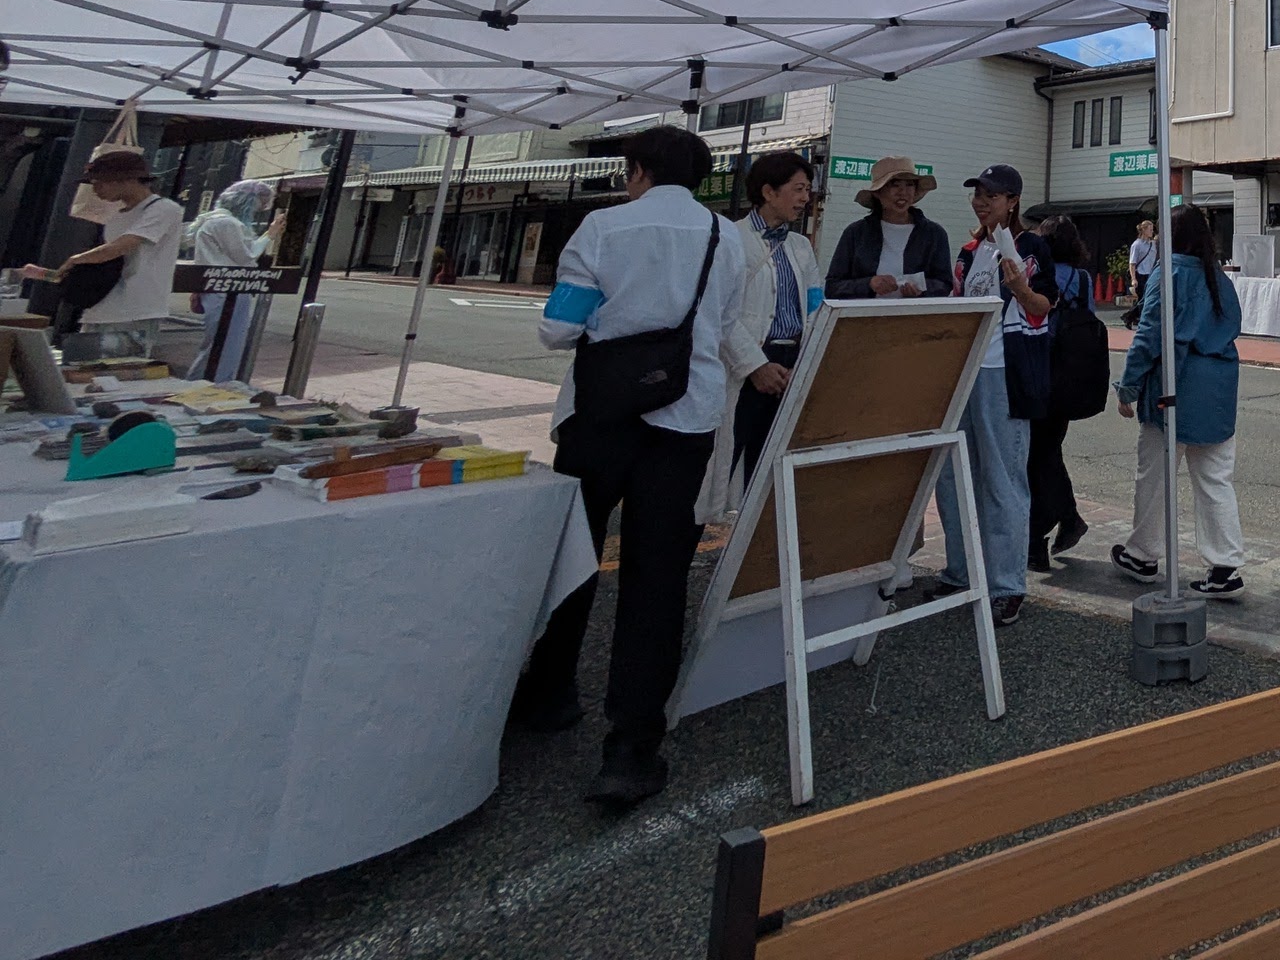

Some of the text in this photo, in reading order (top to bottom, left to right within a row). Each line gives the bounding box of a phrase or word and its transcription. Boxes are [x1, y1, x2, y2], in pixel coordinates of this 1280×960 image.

[1113, 153, 1158, 172] 渡辺薬局
[204, 279, 270, 292] FESTIVAL
